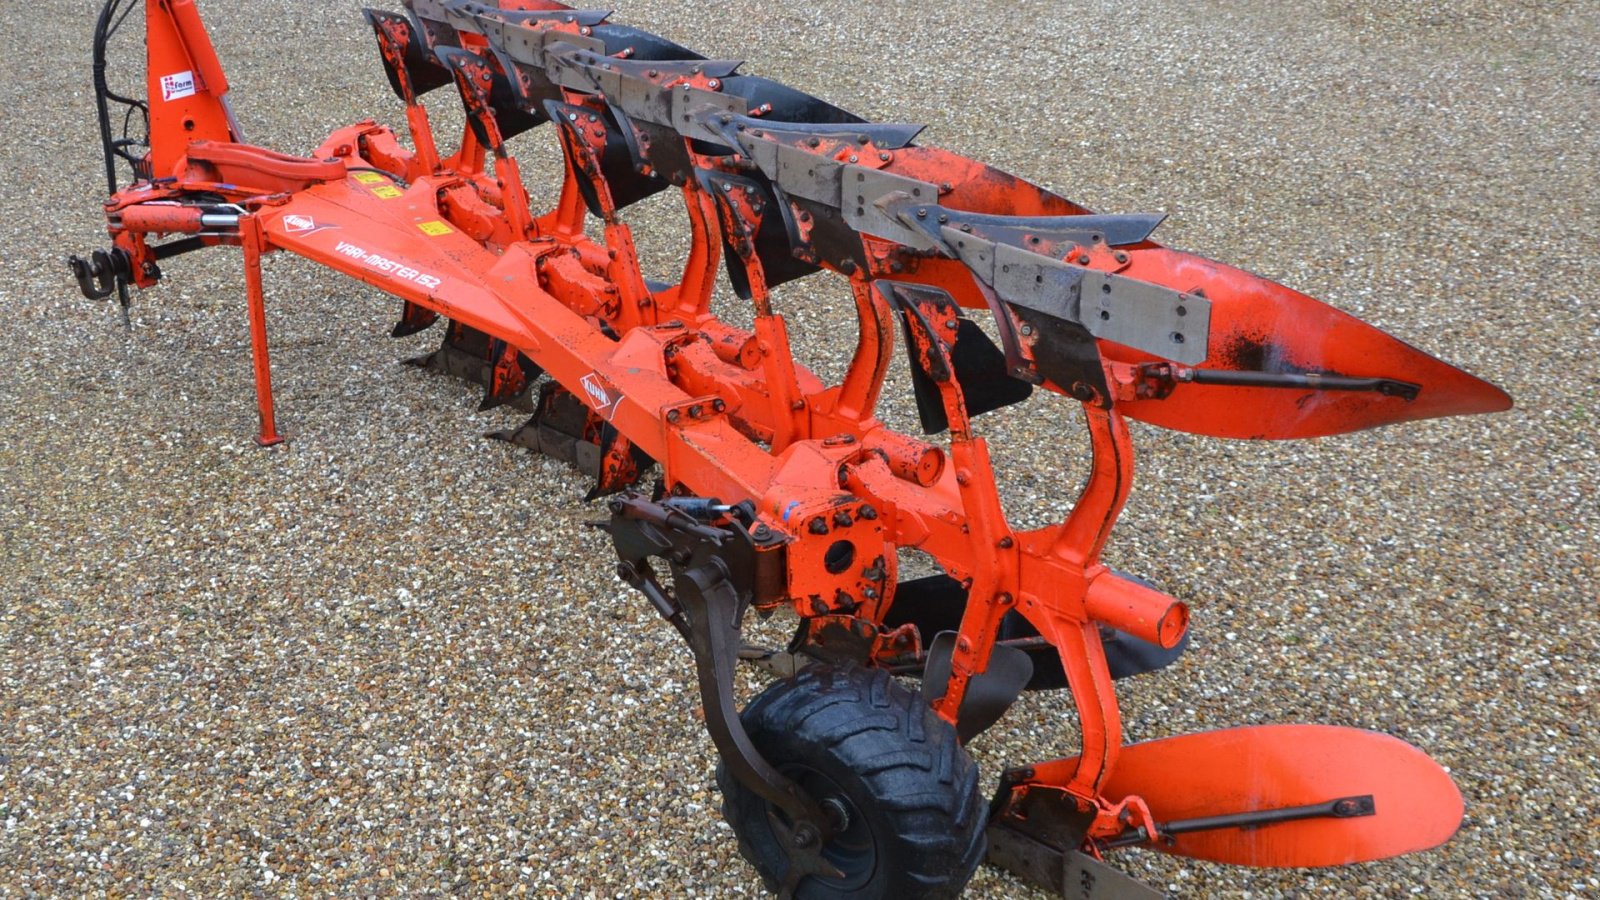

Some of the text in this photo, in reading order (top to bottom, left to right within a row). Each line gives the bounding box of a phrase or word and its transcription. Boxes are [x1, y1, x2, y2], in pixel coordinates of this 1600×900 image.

[286, 214, 314, 228] KUHN
[335, 241, 441, 288] VARI-MASTER 152
[584, 378, 607, 404] KUHN
